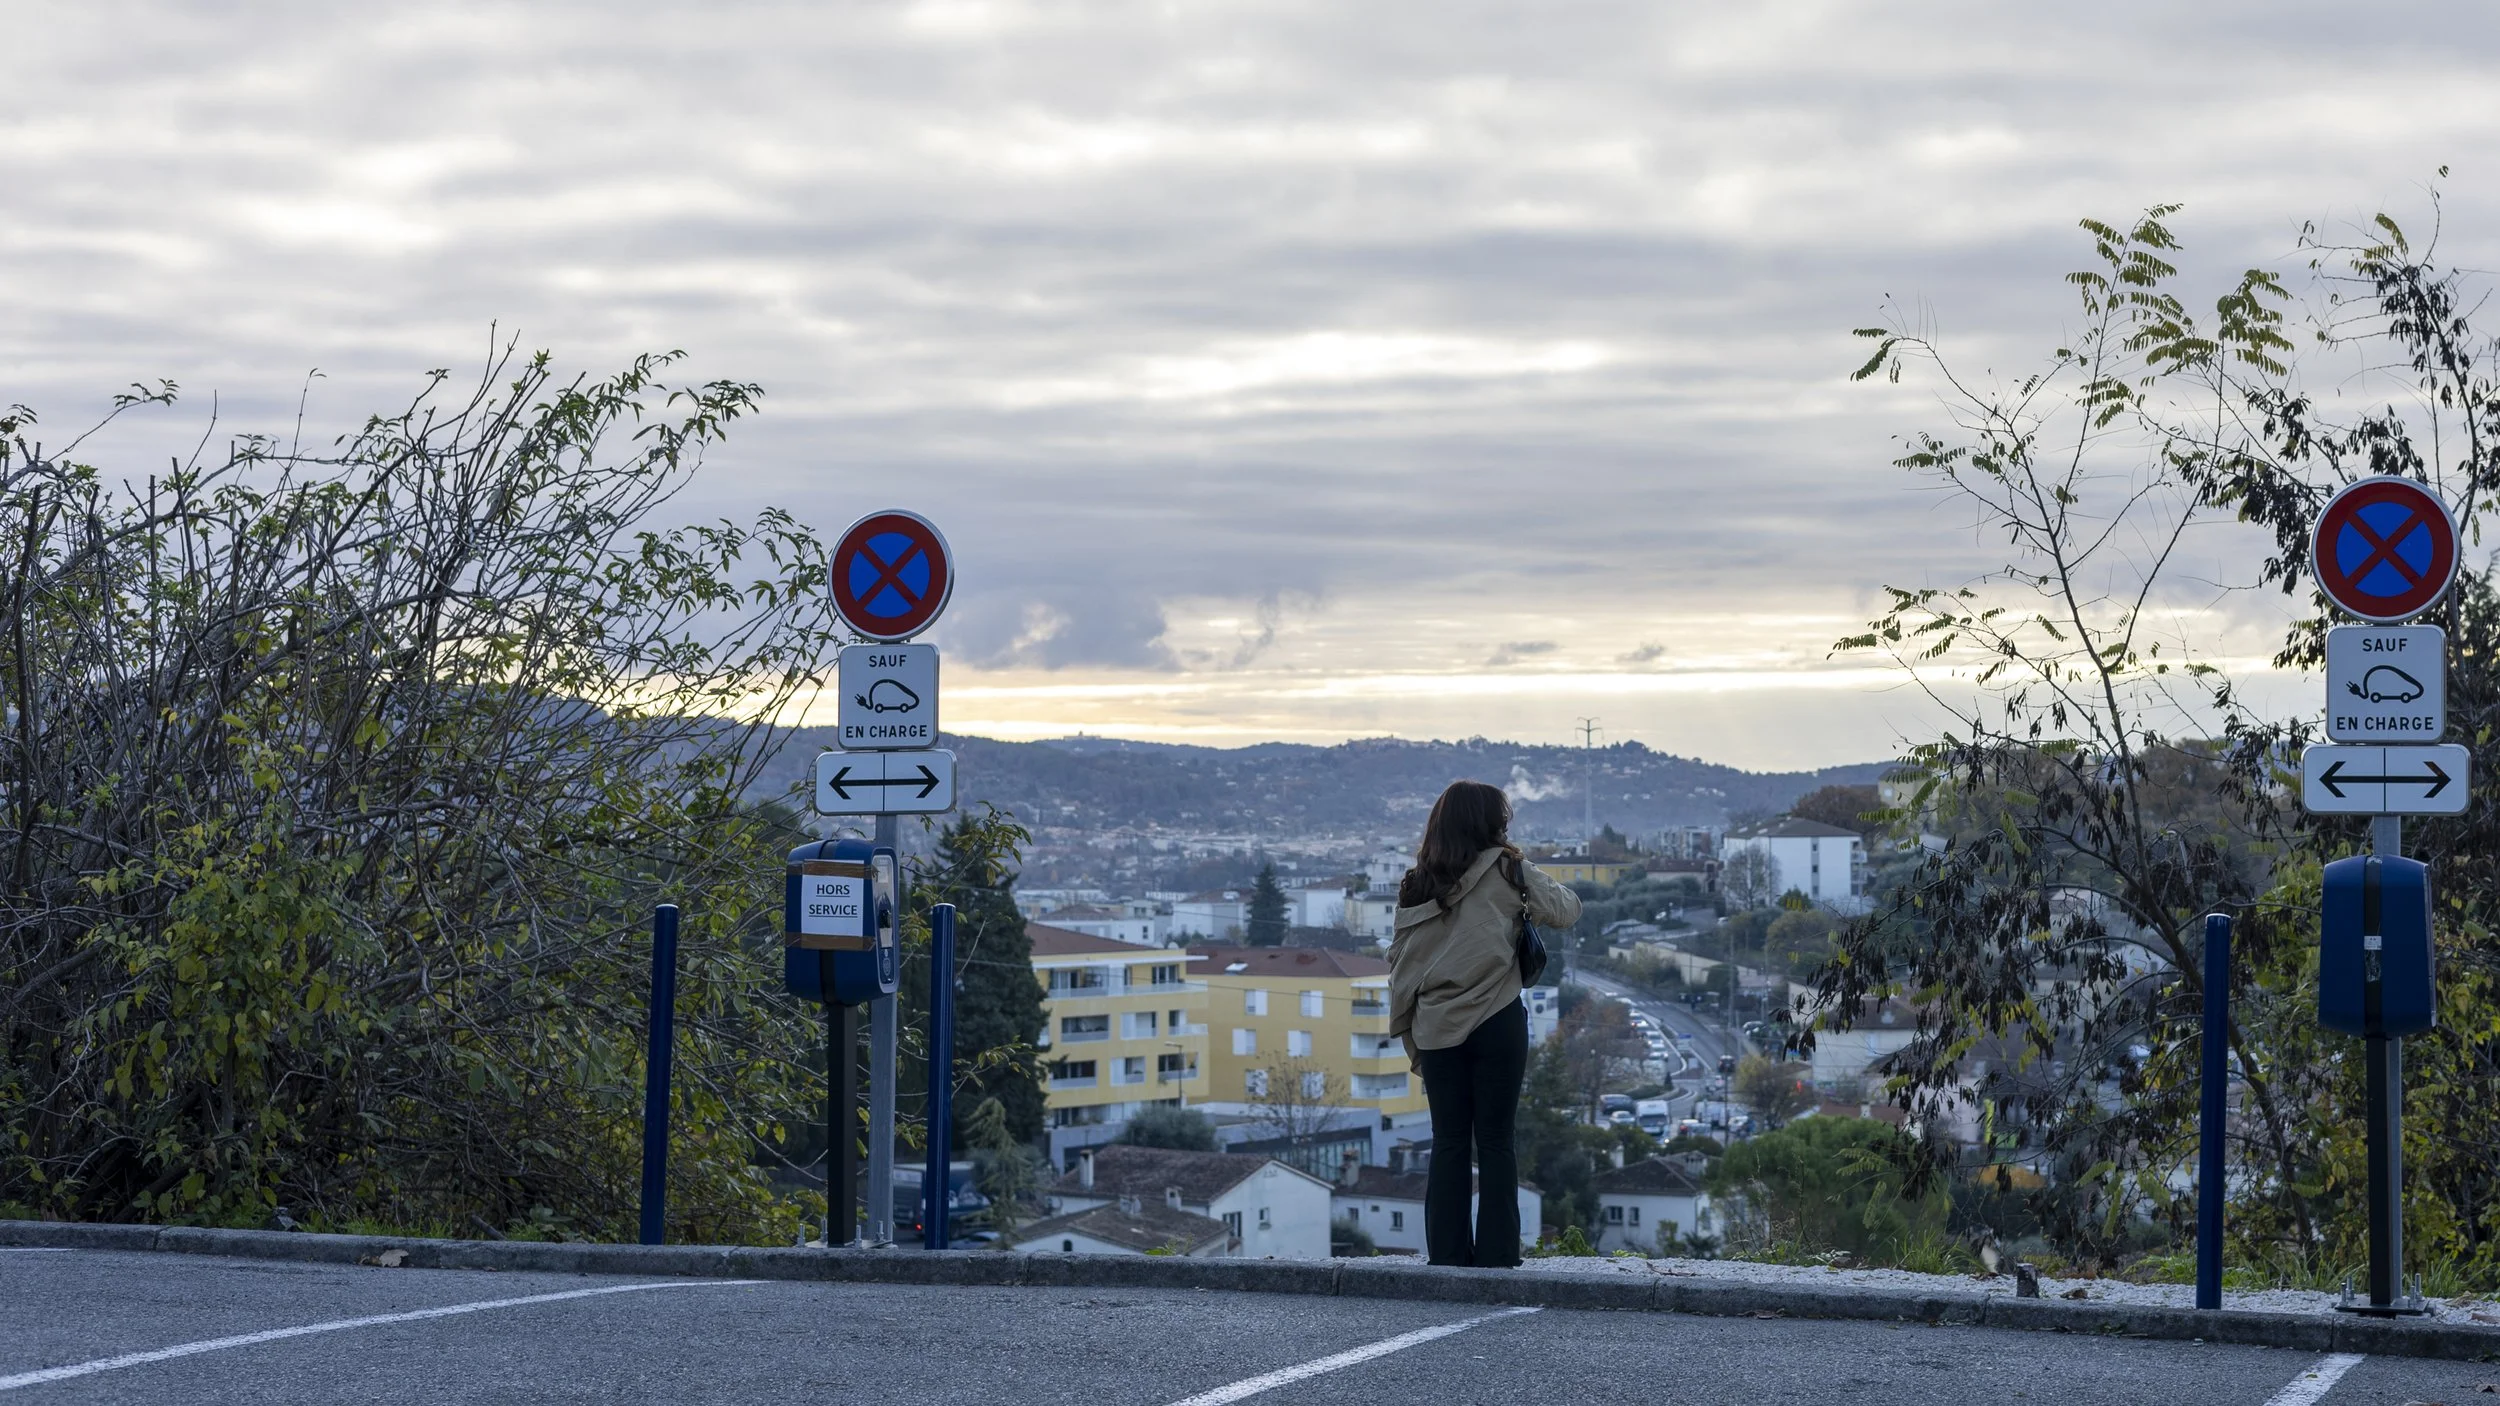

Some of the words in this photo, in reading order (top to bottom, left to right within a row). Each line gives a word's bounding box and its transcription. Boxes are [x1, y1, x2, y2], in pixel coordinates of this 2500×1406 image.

[2362, 638, 2408, 652] SAUF
[868, 654, 907, 668] SAUF
[2336, 716, 2358, 731] EN
[2364, 716, 2434, 731] CHARGE
[845, 725, 864, 738] EN
[869, 724, 928, 738] CHARGE
[816, 883, 850, 895] HORS
[808, 903, 858, 916] SERVICE
